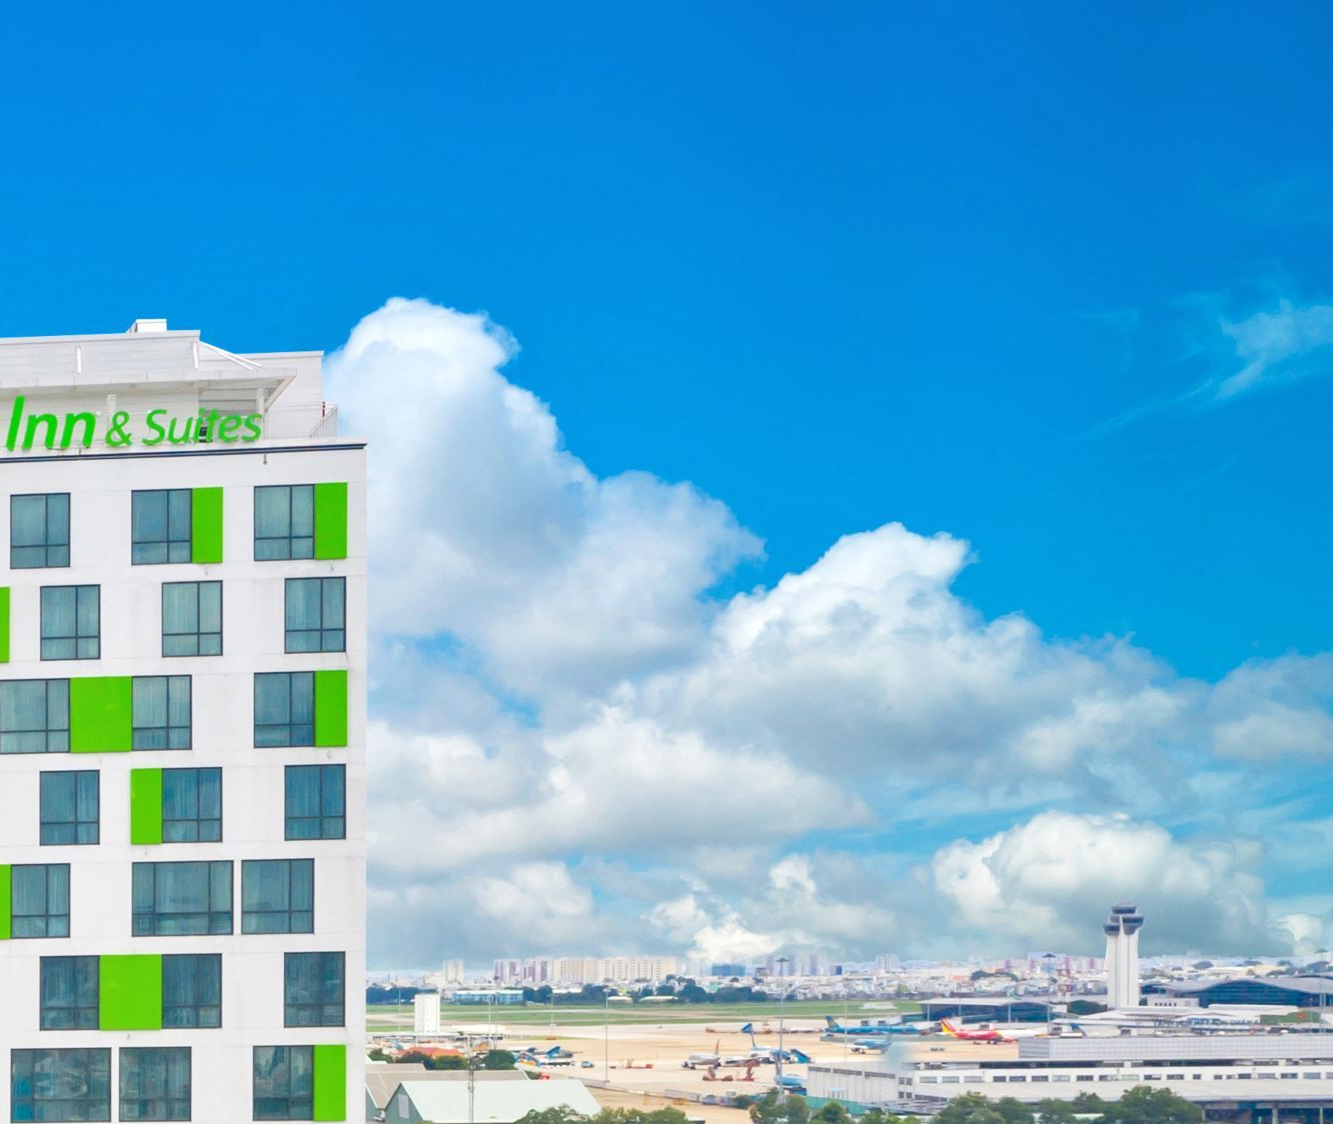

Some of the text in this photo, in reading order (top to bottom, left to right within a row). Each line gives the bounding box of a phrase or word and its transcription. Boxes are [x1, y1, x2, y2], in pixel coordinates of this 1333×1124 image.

[6, 395, 96, 451] Inn
[105, 411, 132, 448] &
[142, 407, 262, 446] Suites
